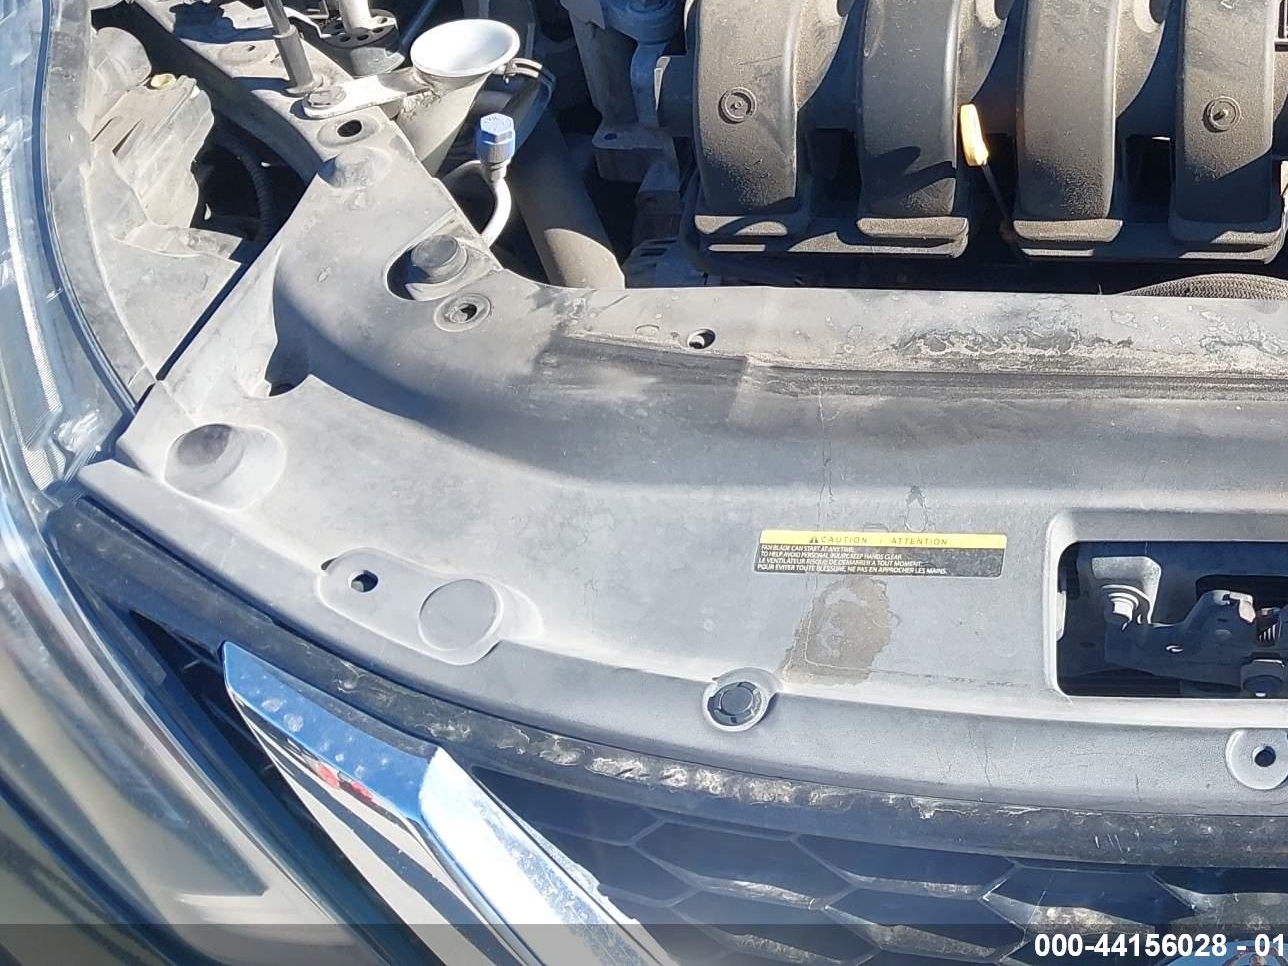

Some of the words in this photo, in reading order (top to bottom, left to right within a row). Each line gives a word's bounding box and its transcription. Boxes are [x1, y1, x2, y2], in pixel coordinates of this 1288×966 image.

[821, 536, 868, 544] CAUTION
[891, 537, 948, 546] ATTENTION
[767, 557, 806, 565] VENTILATEUR
[758, 563, 774, 571] POUR
[797, 564, 816, 572] TOUTE
[857, 565, 868, 573] PAS
[879, 566, 914, 574] APPROCHER
